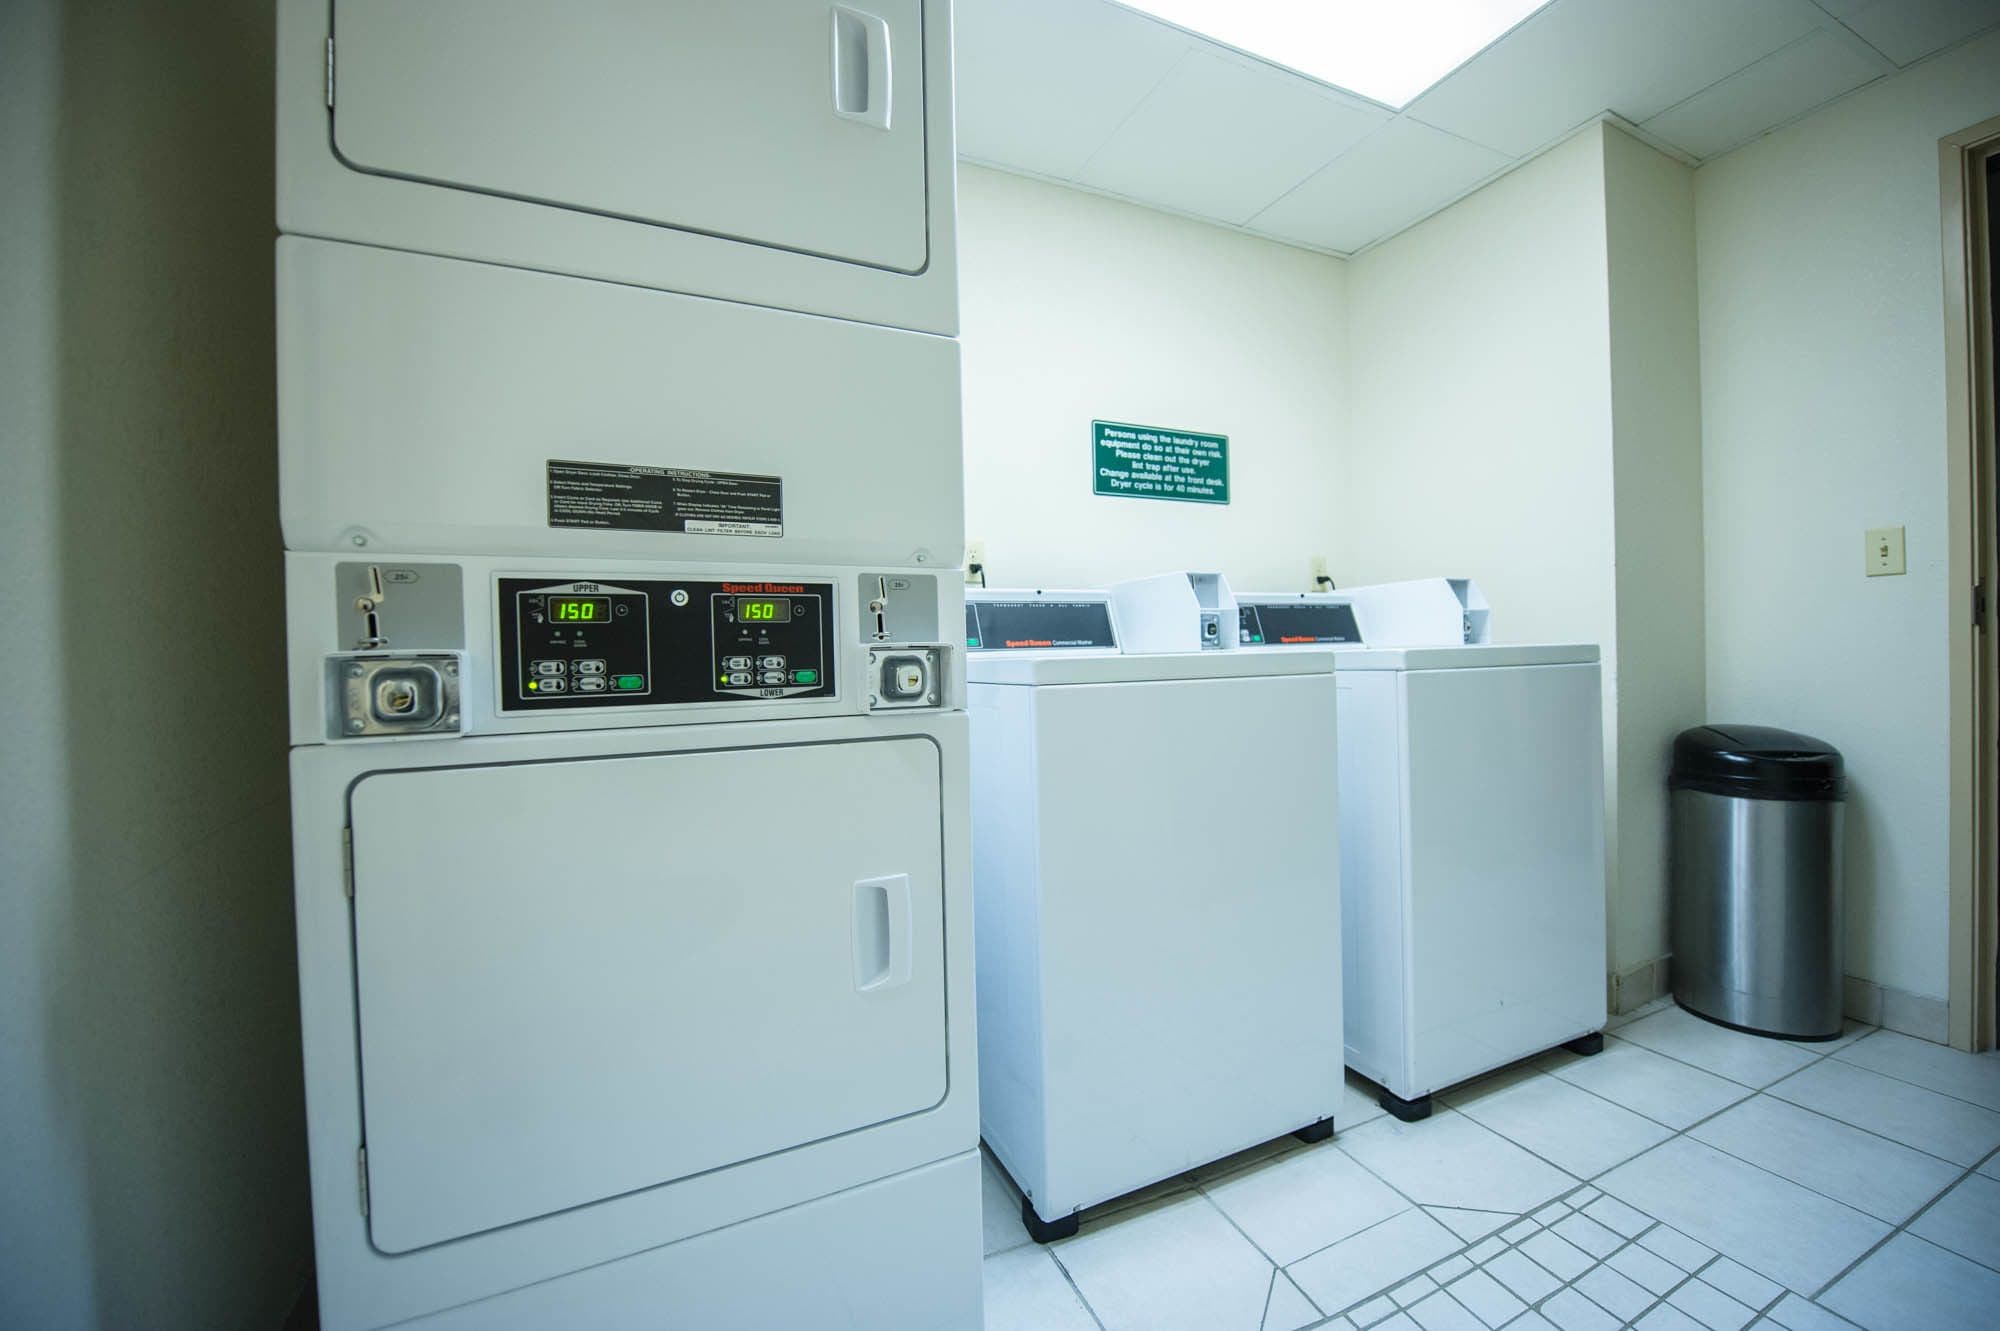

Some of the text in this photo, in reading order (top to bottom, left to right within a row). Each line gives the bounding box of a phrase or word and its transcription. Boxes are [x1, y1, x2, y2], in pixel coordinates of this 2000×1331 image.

[1104, 428, 1219, 449] Persons using the laundry room
[1100, 439, 1140, 449] equipment
[1142, 443, 1152, 451] do
[1175, 446, 1190, 454] their
[1208, 450, 1223, 458] risk.
[1115, 449, 1141, 460] Please
[1143, 453, 1163, 461] clean
[1178, 456, 1190, 464] the
[1192, 458, 1210, 468] dryer
[1132, 460, 1144, 469] lint
[1145, 462, 1161, 472] trap
[1162, 464, 1179, 473] after
[1100, 467, 1129, 479] Change
[1131, 471, 1163, 480] available
[1174, 475, 1186, 483] the
[1187, 475, 1204, 485] front
[1206, 478, 1225, 487] desk.
[1111, 478, 1132, 489] Dryer
[1134, 482, 1153, 490] cycle
[1155, 482, 1161, 490] is
[1164, 482, 1174, 491] for
[1187, 485, 1215, 495] minutes.
[573, 584, 599, 592] UPPER
[721, 583, 804, 595] Speed Queen
[560, 603, 594, 619] 150
[745, 604, 774, 619] 150
[1006, 639, 1028, 648] Speed
[760, 688, 784, 697] LOWER
